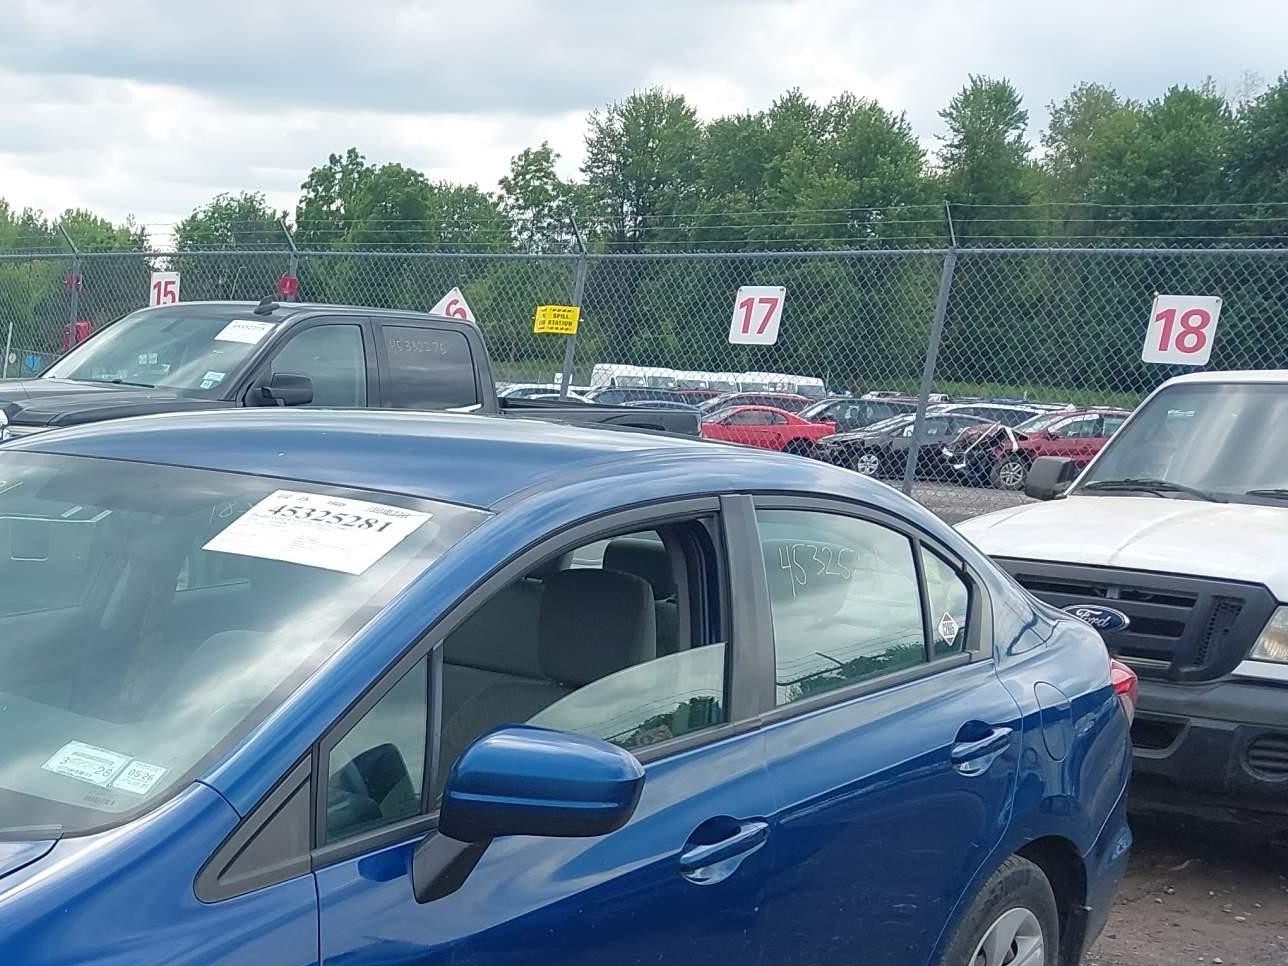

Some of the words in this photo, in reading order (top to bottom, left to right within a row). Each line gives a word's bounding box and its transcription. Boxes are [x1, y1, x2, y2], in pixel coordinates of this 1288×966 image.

[153, 280, 176, 305] 15
[739, 297, 780, 335] 17
[1155, 308, 1212, 354] 18
[268, 503, 393, 533] 45325281
[1075, 608, 1112, 627] Ford
